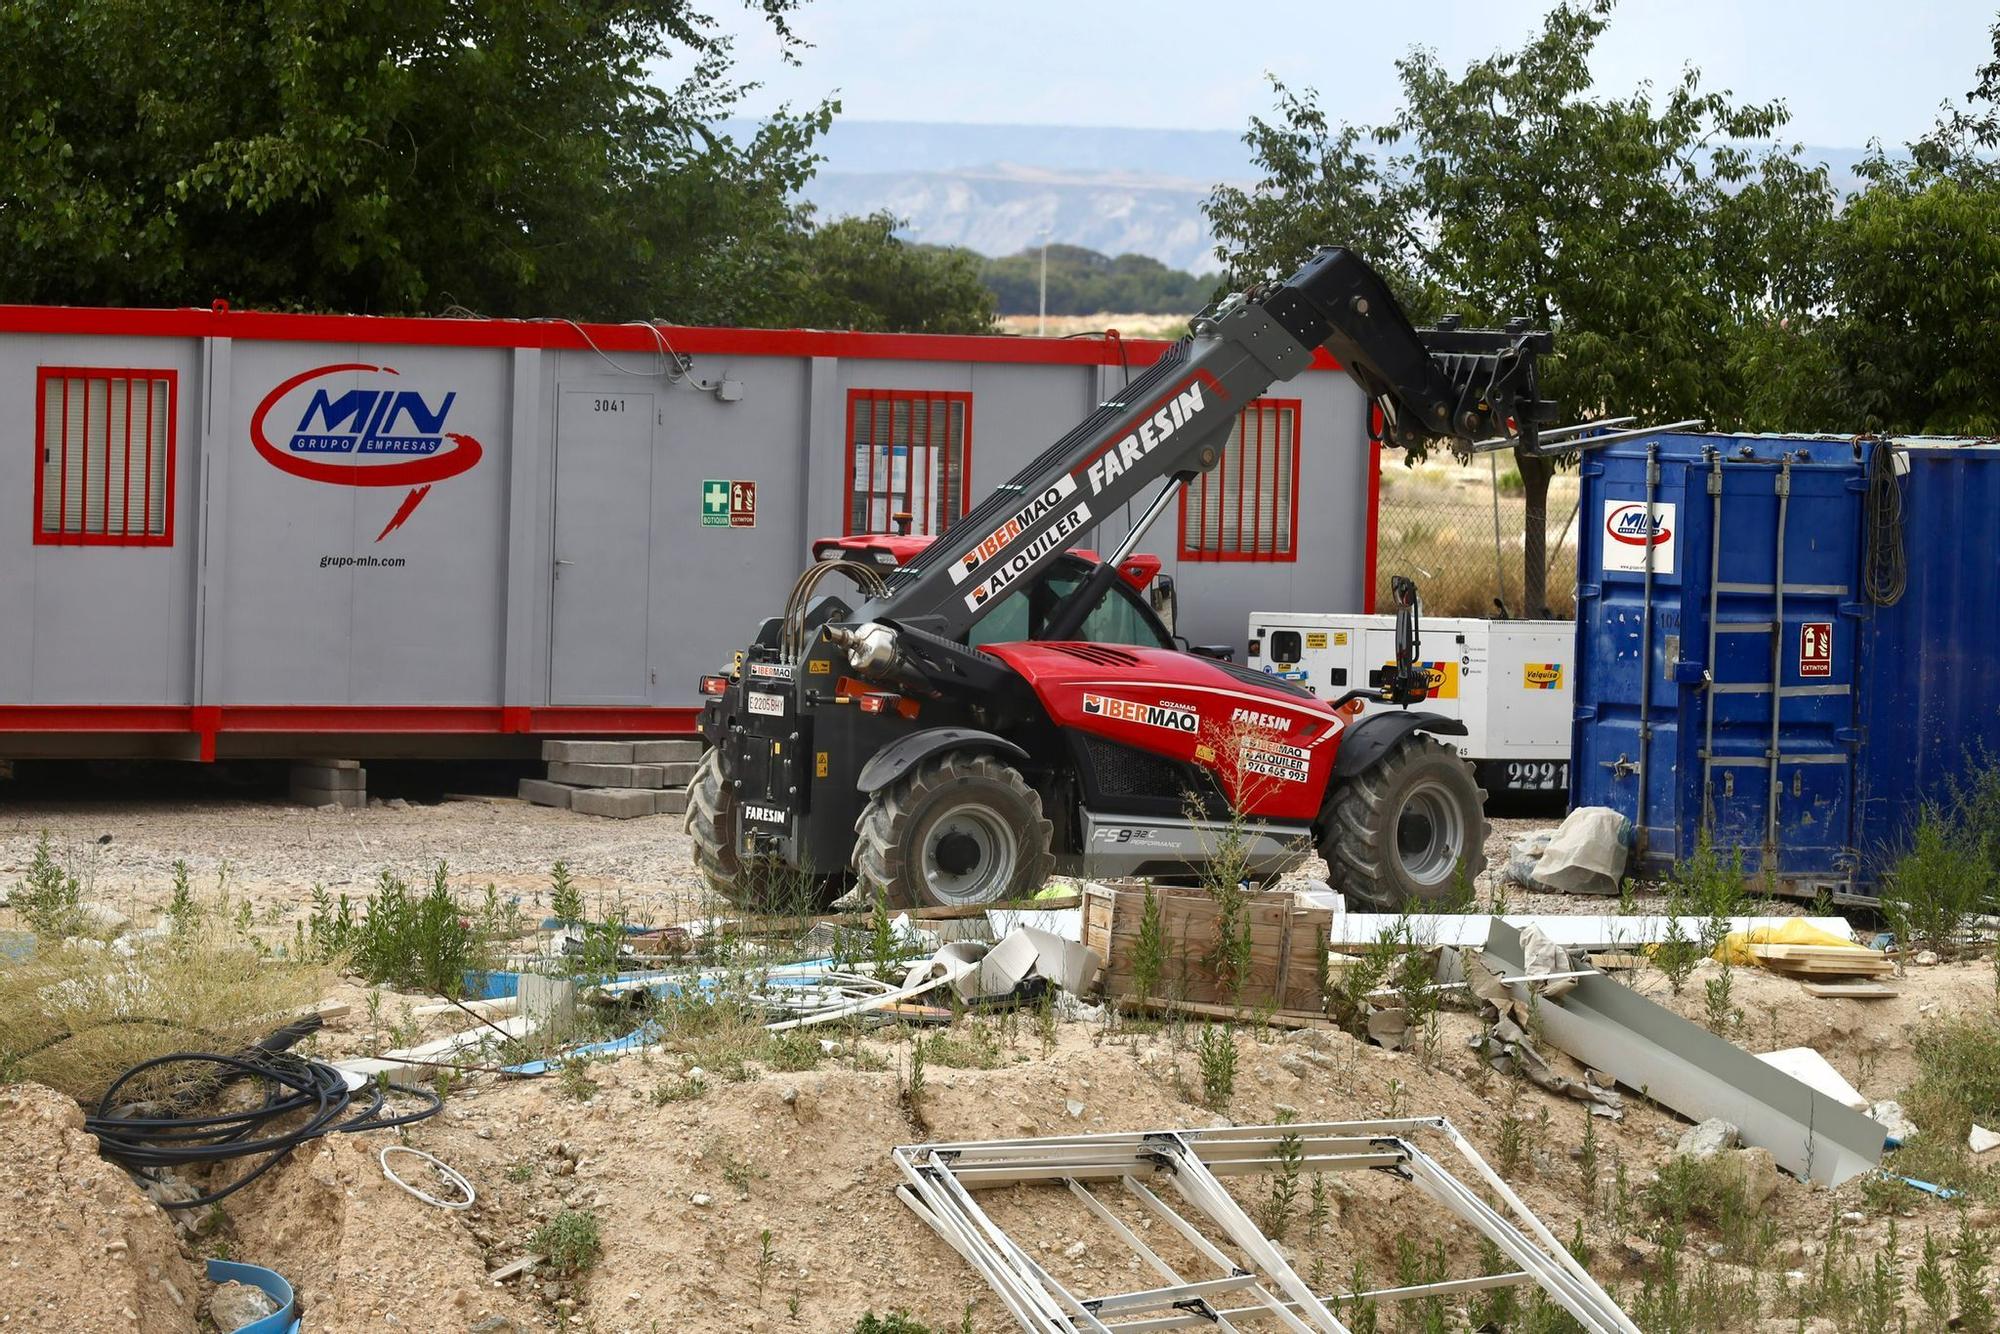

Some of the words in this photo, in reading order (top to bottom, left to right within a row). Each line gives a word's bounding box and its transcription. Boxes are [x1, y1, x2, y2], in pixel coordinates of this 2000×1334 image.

[594, 399, 626, 412] 3041
[297, 438, 350, 449] GRUPO
[366, 440, 437, 452] EMPRESAS
[1086, 381, 1205, 496] FARESIN
[979, 487, 1063, 562] IBERMAQ
[989, 510, 1082, 594] ALQUILER
[319, 555, 406, 568] grupo-mln.com
[757, 666, 790, 677] IBERMAQ
[1527, 671, 1558, 679] Valquisa
[1159, 700, 1197, 712] COZAMAQ
[1102, 699, 1196, 732] IBERMAQ
[1231, 708, 1291, 731] FARESIN
[1248, 761, 1265, 773] 976
[1288, 770, 1306, 782] 993
[1508, 762, 1568, 789] 2221
[745, 806, 785, 824] FARESIN
[1130, 839, 1182, 848] PERFORMANCE
